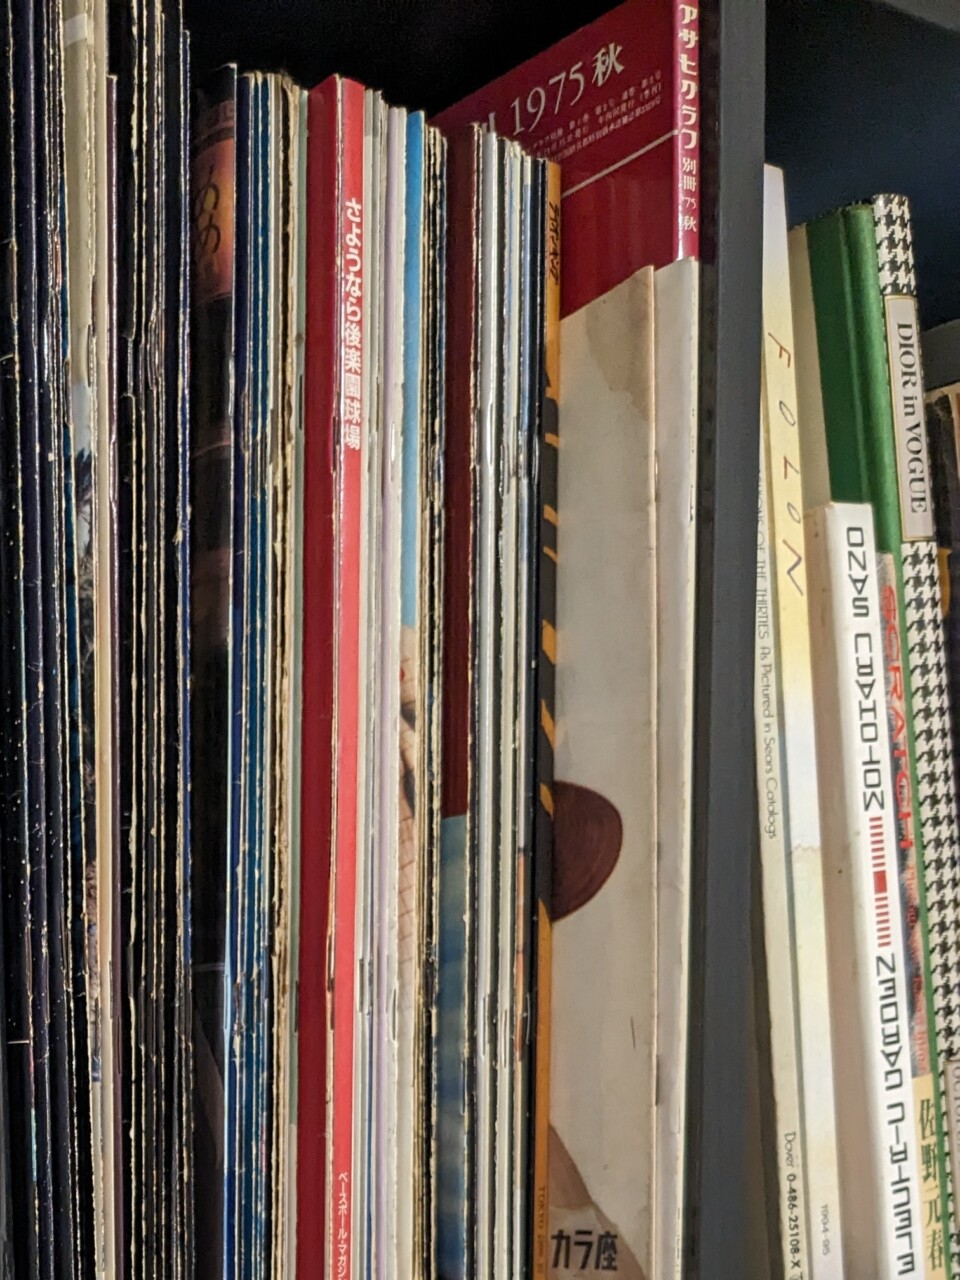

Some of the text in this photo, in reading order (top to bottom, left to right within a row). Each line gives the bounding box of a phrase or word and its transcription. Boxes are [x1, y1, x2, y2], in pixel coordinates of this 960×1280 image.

[511, 61, 585, 135] 1975
[592, 43, 625, 87] 秋
[897, 323, 928, 514] DIOR in VOGUE
[761, 664, 780, 839] Pictured in Sears Catalogs
[785, 1131, 800, 1269] Dover 0-486-25108-X
[919, 1099, 944, 1271] 佐野元春
